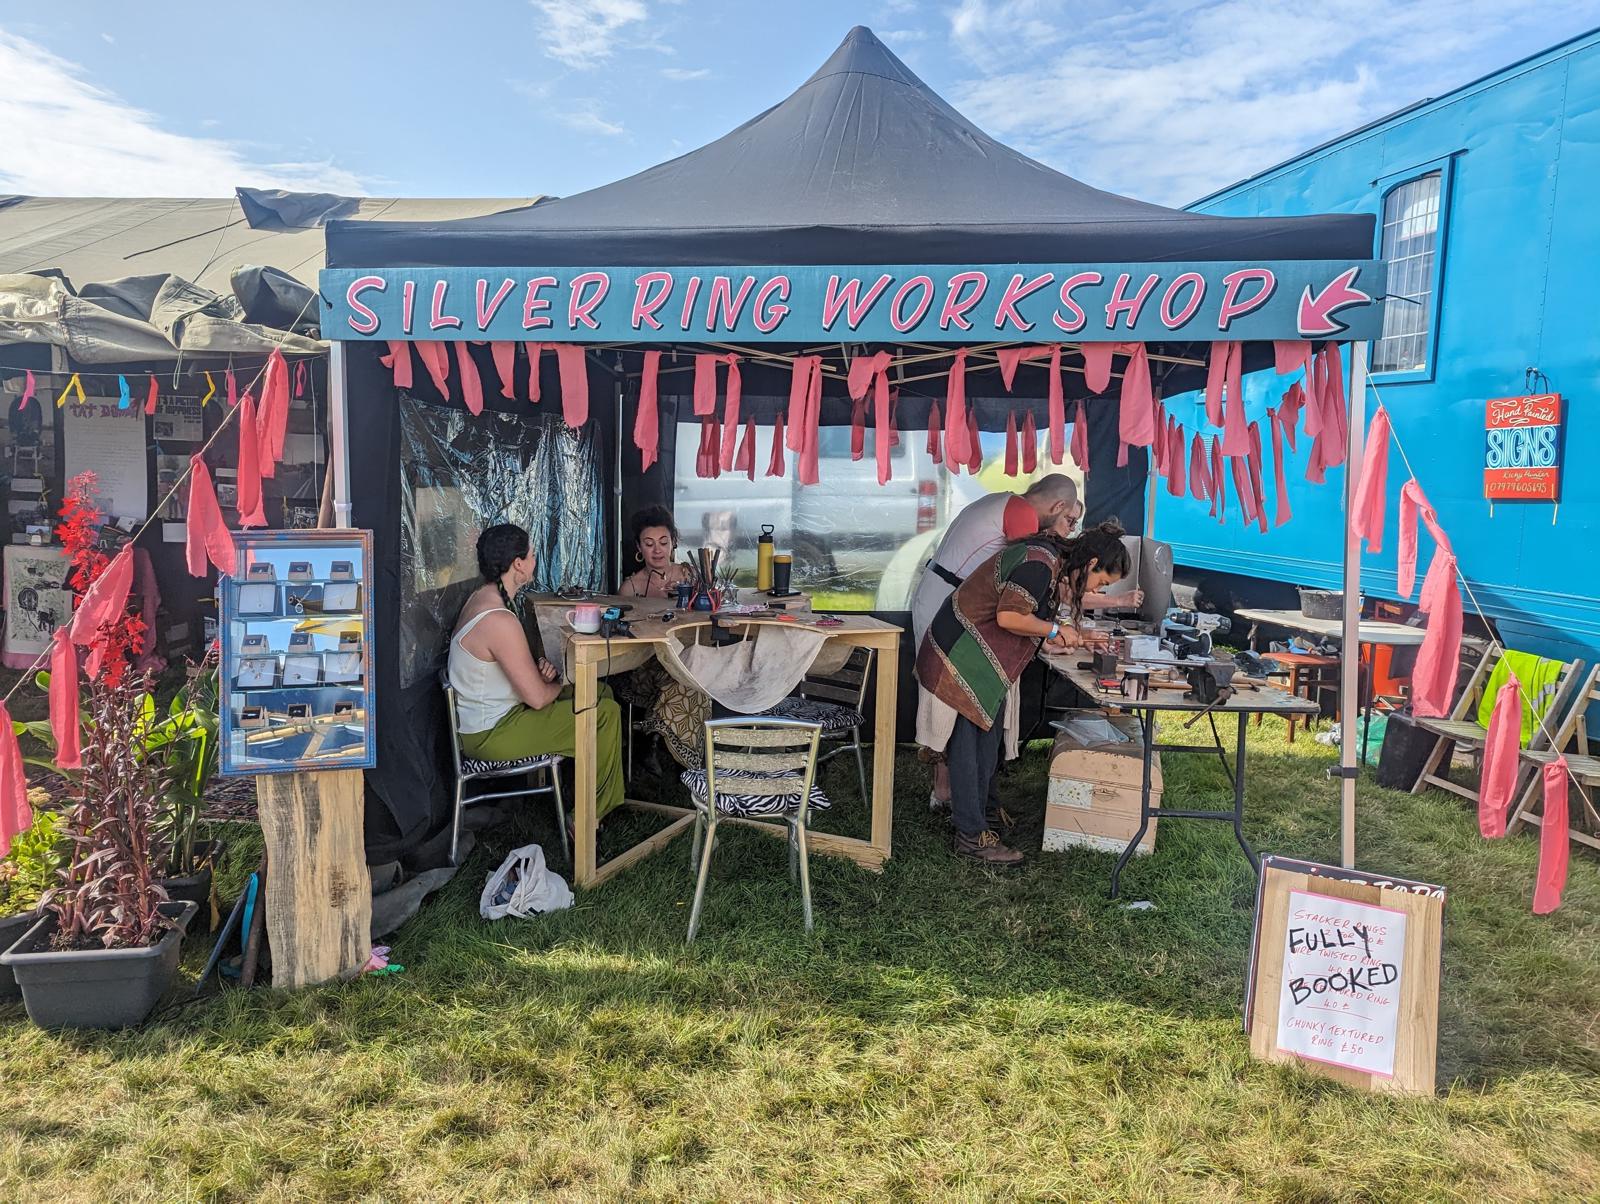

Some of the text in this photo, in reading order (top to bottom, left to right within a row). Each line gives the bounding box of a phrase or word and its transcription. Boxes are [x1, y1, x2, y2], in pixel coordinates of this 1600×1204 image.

[346, 268, 1279, 334] SILVER RING WORKSHOP
[1492, 403, 1556, 425] Hand Painted
[1486, 426, 1557, 468] SIGNS
[1294, 909, 1387, 936] STACKER RNGS
[1289, 925, 1371, 959] FULLY
[1319, 949, 1357, 961] TWISTED
[1360, 955, 1383, 967] RING
[1289, 963, 1398, 1005] BOOKED
[1366, 993, 1390, 1005] RING
[1286, 1017, 1384, 1044] CHUNKY TEXTURED
[1311, 1035, 1334, 1047] RING
